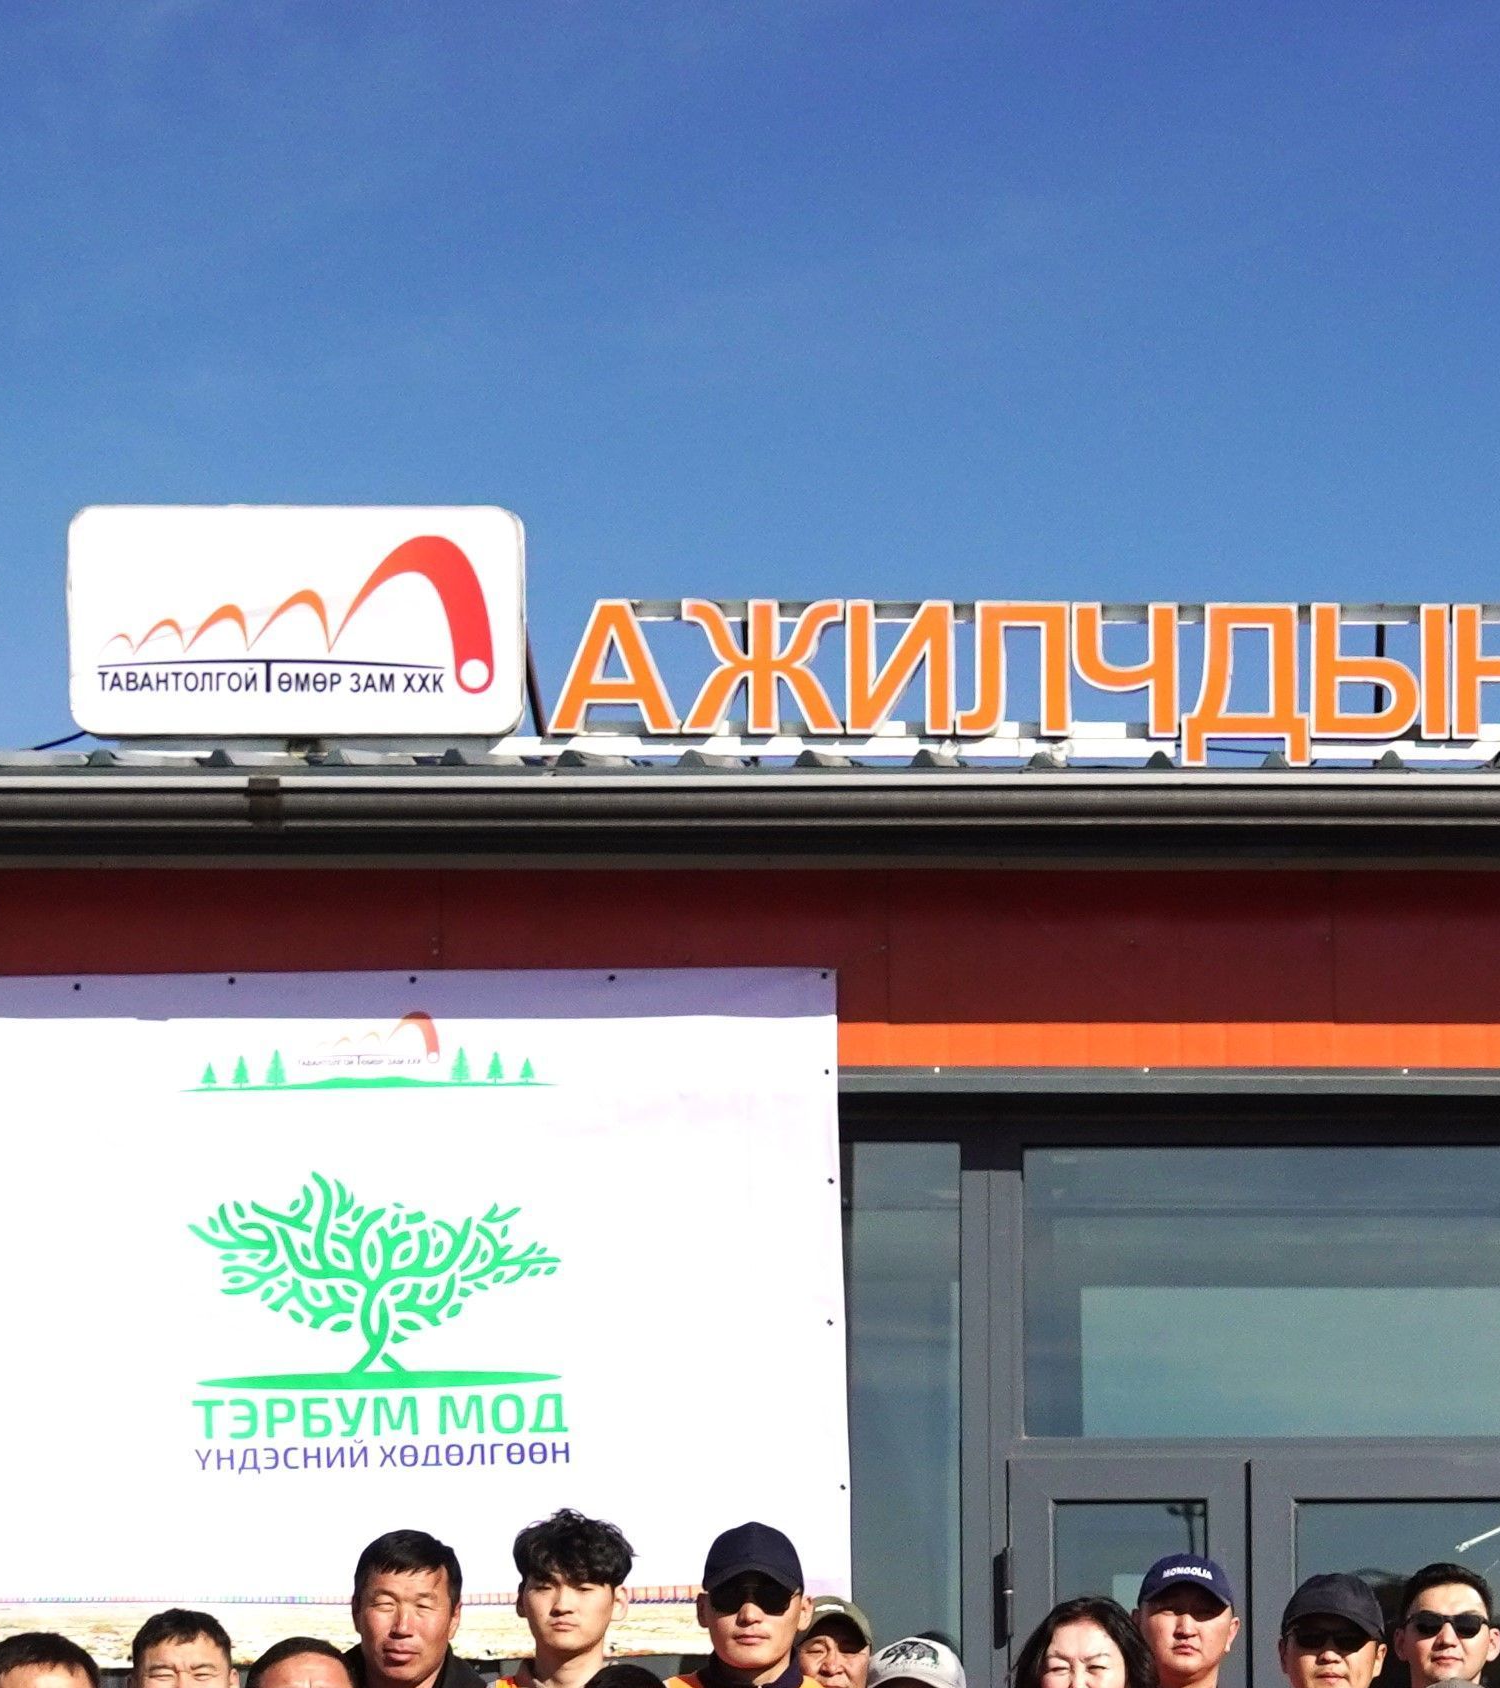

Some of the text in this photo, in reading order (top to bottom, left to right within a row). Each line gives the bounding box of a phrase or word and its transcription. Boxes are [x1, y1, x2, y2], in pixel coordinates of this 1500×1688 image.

[97, 661, 445, 694] ТАВАНТОЛГОЙ ТӨМӨР ЗАМ ХХК
[192, 1392, 569, 1440] ТЭРБУМ МОД
[195, 1440, 571, 1475] ҮНДЭСНИЙ ХӨДӨЛГӨӨН
[1162, 1566, 1213, 1580] MONGOLIA
